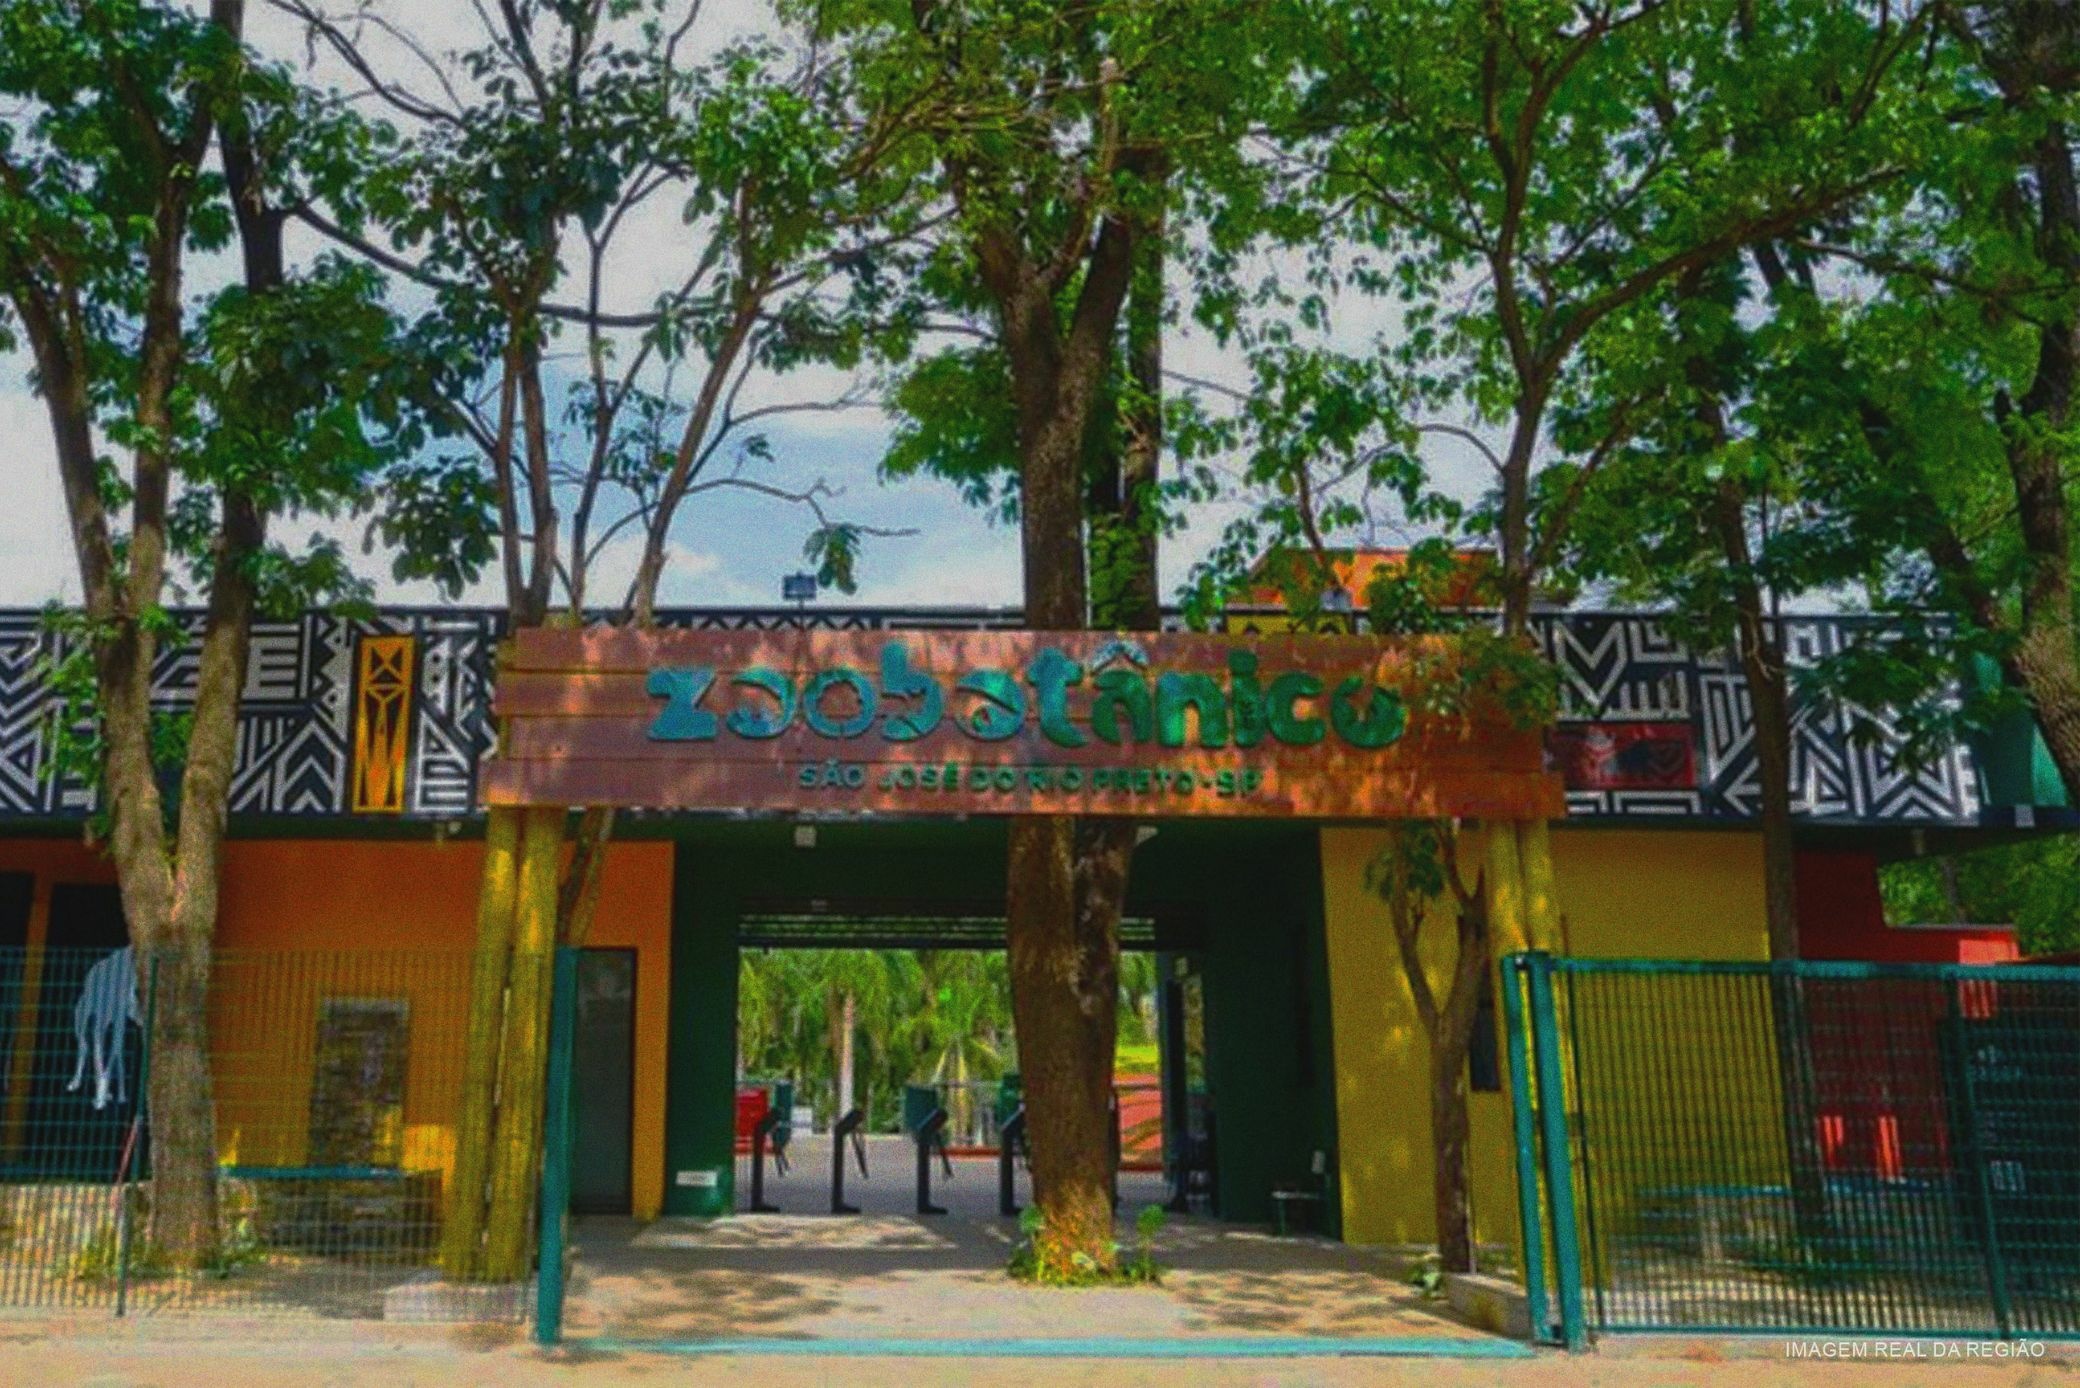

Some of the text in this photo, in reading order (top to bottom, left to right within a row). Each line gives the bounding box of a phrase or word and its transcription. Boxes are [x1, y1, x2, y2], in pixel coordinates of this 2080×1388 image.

[799, 757, 864, 789] SÃO
[877, 760, 959, 792] JOSÉ
[968, 764, 1018, 793] DO
